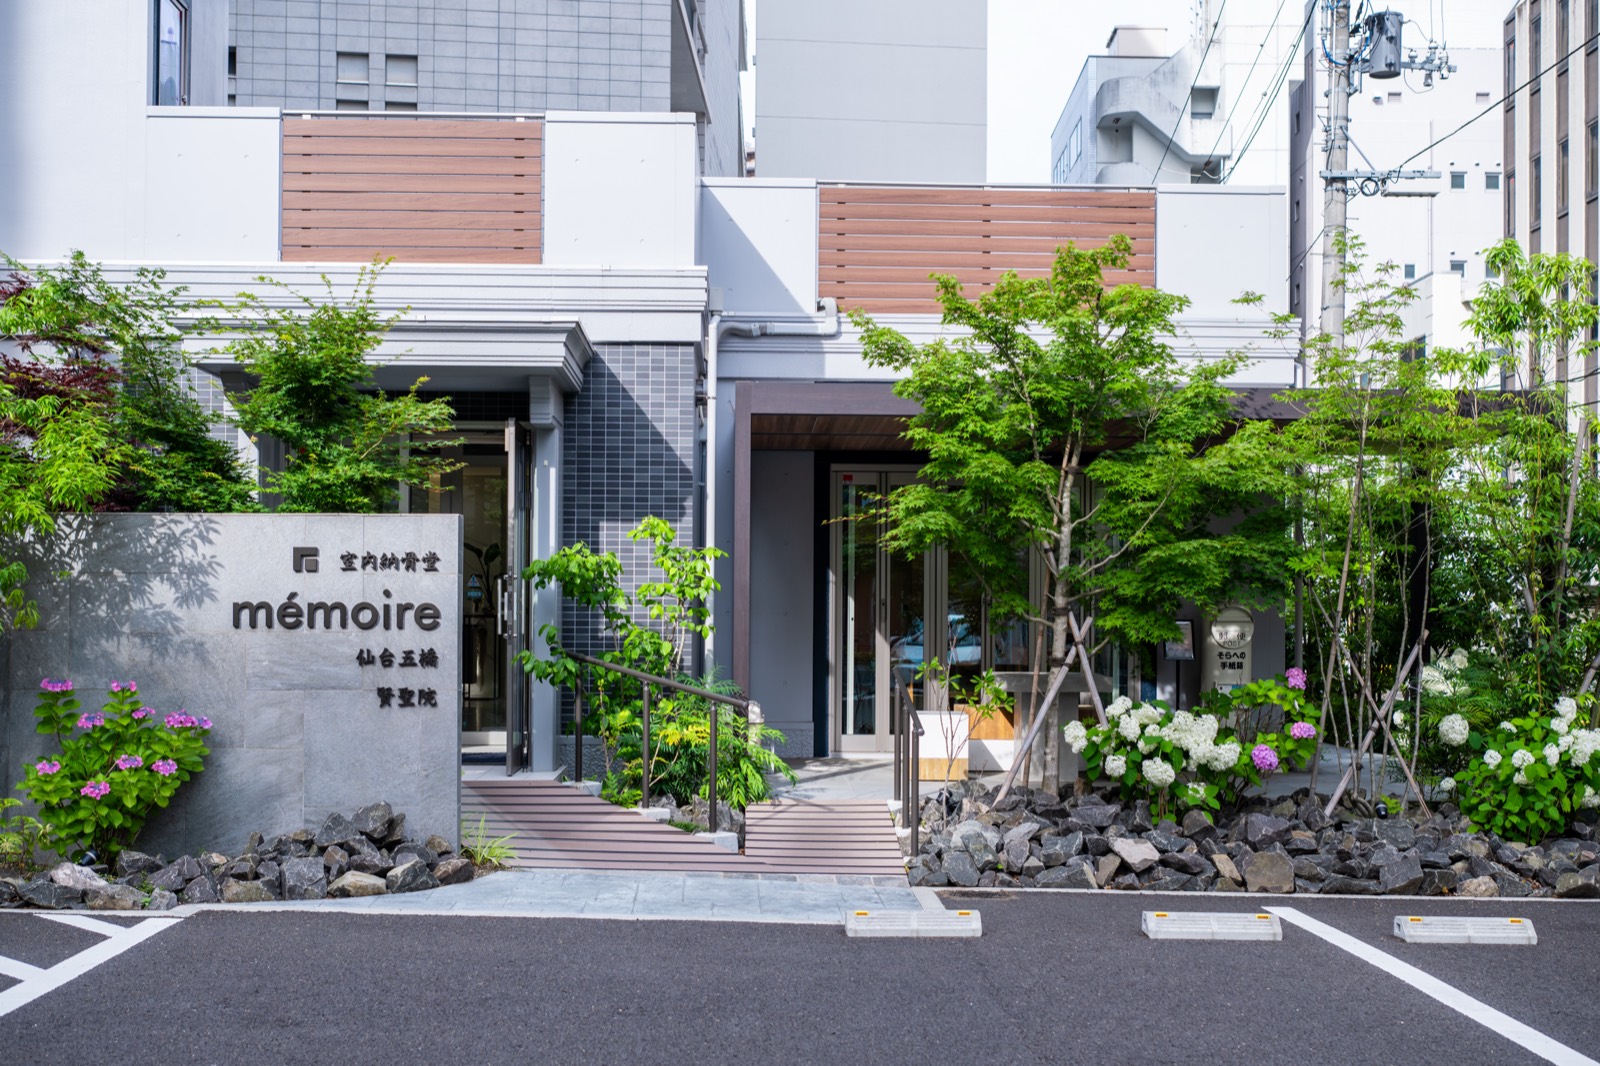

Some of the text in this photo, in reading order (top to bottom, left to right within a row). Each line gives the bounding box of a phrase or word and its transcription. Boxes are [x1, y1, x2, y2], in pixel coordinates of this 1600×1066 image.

[340, 551, 441, 573] 室内納骨堂
[232, 588, 442, 632] mémoire
[356, 648, 440, 669] 仙台五橋
[1217, 651, 1246, 660] そらへの
[377, 687, 439, 708] 賢聖院
